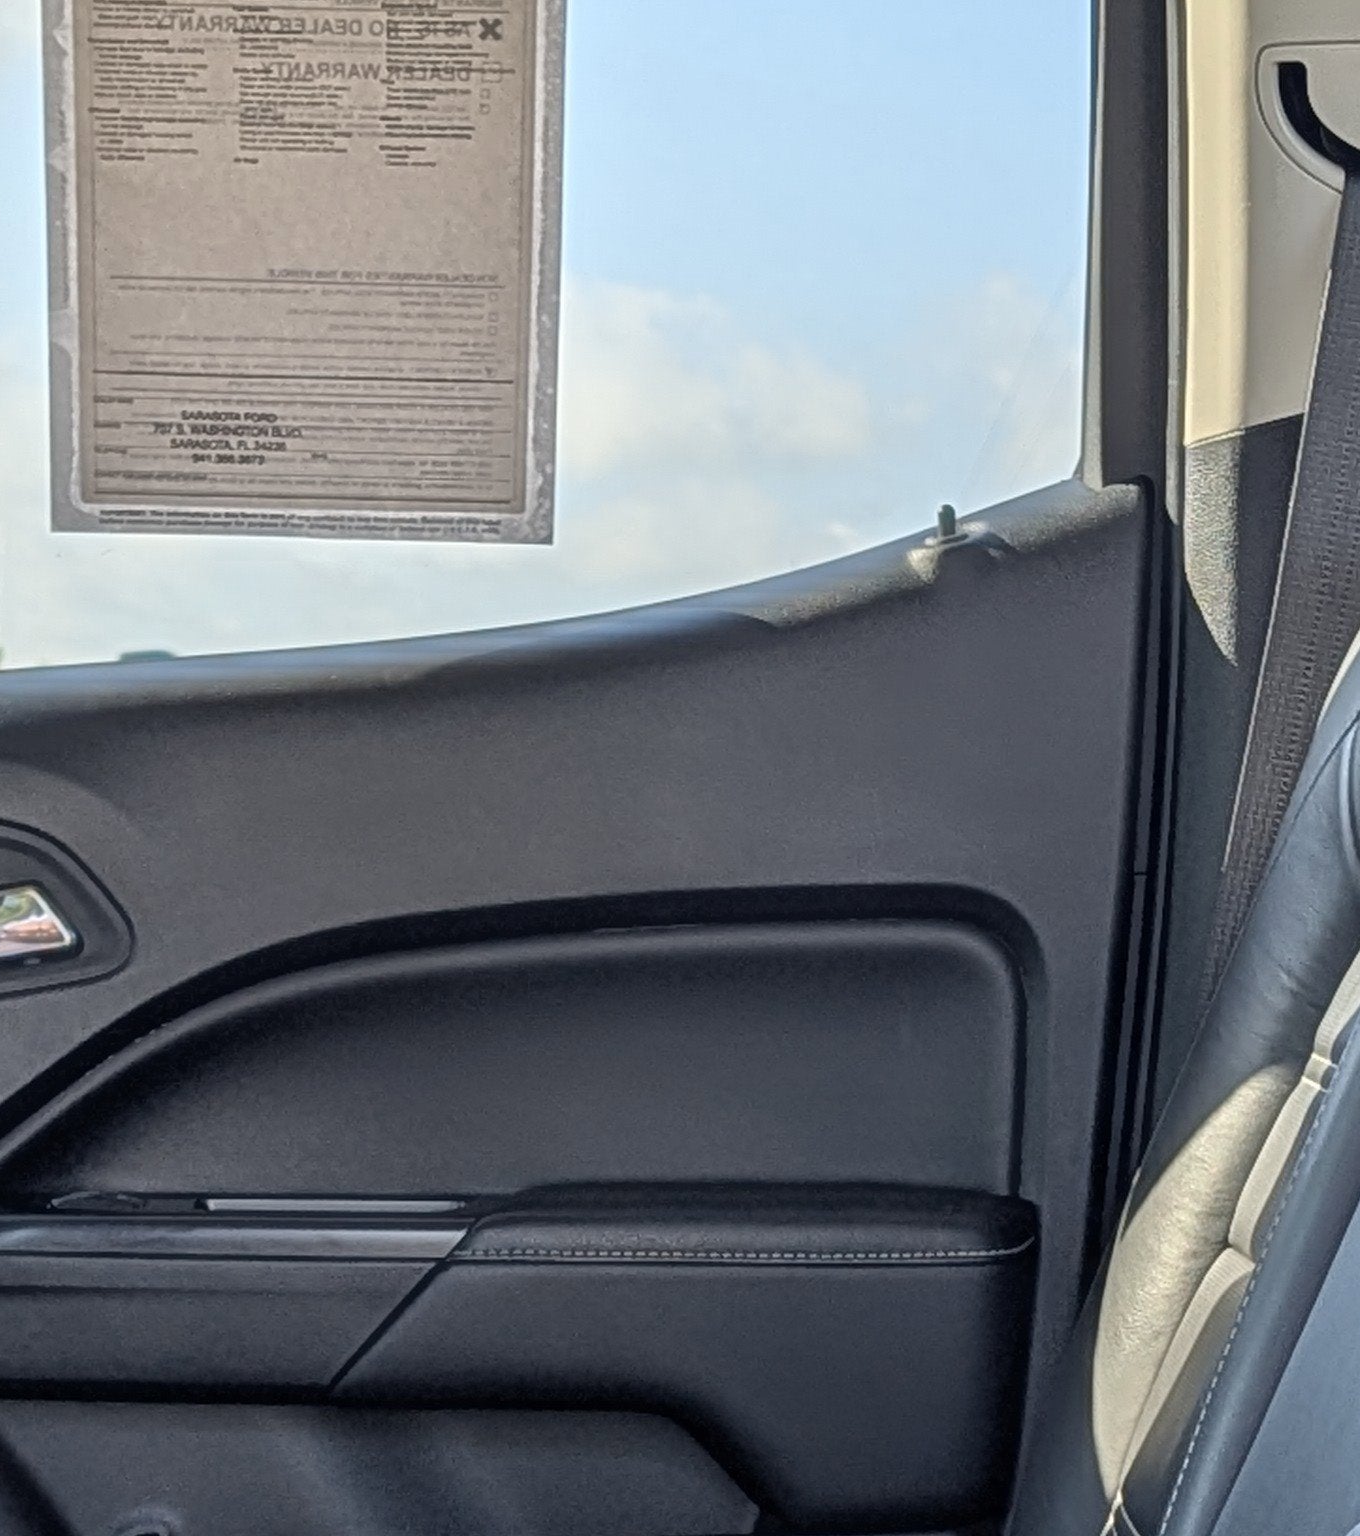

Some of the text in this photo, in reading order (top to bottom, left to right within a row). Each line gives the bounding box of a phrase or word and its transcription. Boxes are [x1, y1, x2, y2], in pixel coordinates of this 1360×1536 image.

[181, 410, 278, 423] SARASOTA FORD
[190, 424, 269, 437] WASHINGTON
